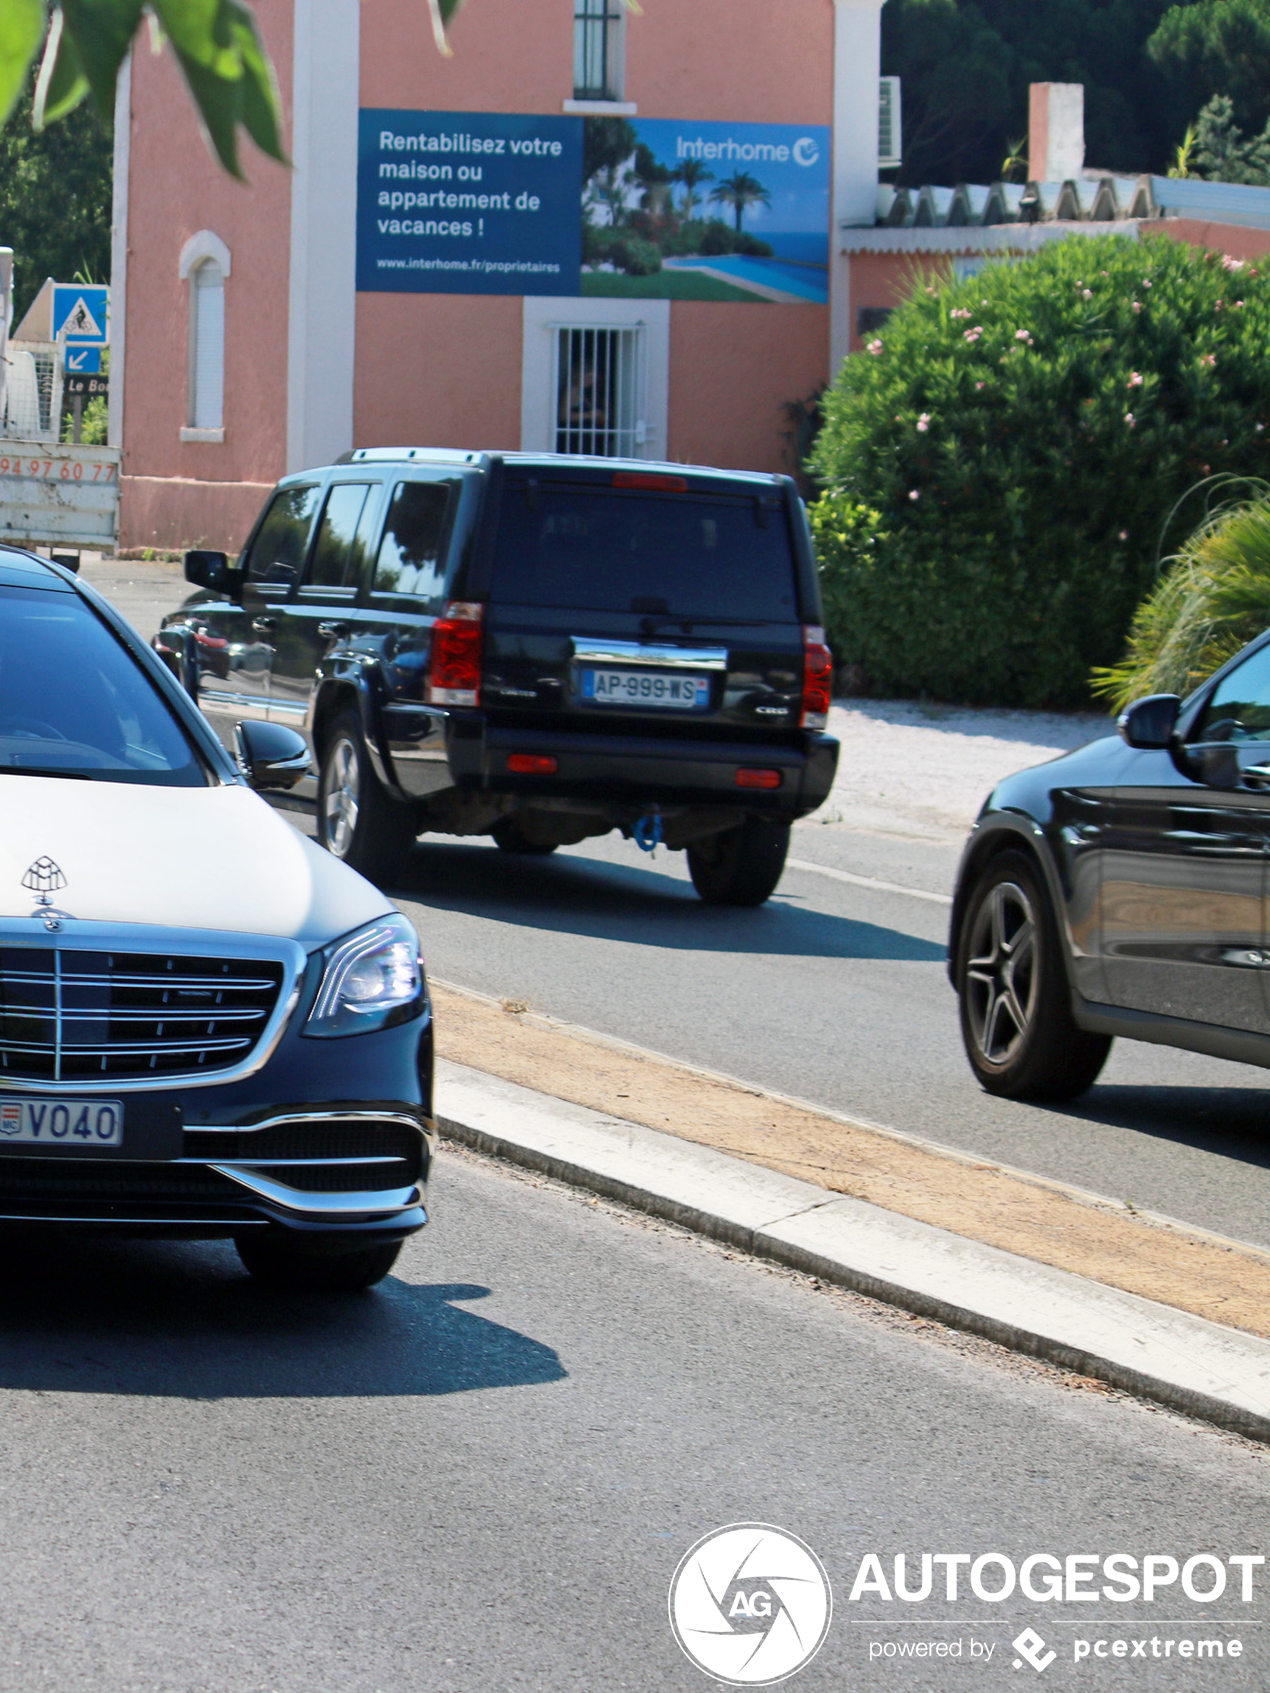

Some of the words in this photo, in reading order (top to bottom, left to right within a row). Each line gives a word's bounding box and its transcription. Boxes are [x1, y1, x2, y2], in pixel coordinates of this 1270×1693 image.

[380, 131, 505, 153] Rentabilisez
[510, 138, 562, 155] votre
[677, 136, 789, 162] Interhome
[379, 160, 452, 179] maison
[458, 166, 482, 180] ou
[378, 190, 510, 210] appartement
[515, 192, 540, 210] de
[378, 219, 472, 236] vacances
[377, 258, 560, 273] www.interhome.fr/proprietaires
[69, 379, 83, 391] Le
[0, 458, 21, 475] 94
[30, 460, 52, 477] 97
[60, 461, 82, 480] 60
[93, 464, 116, 481] 77
